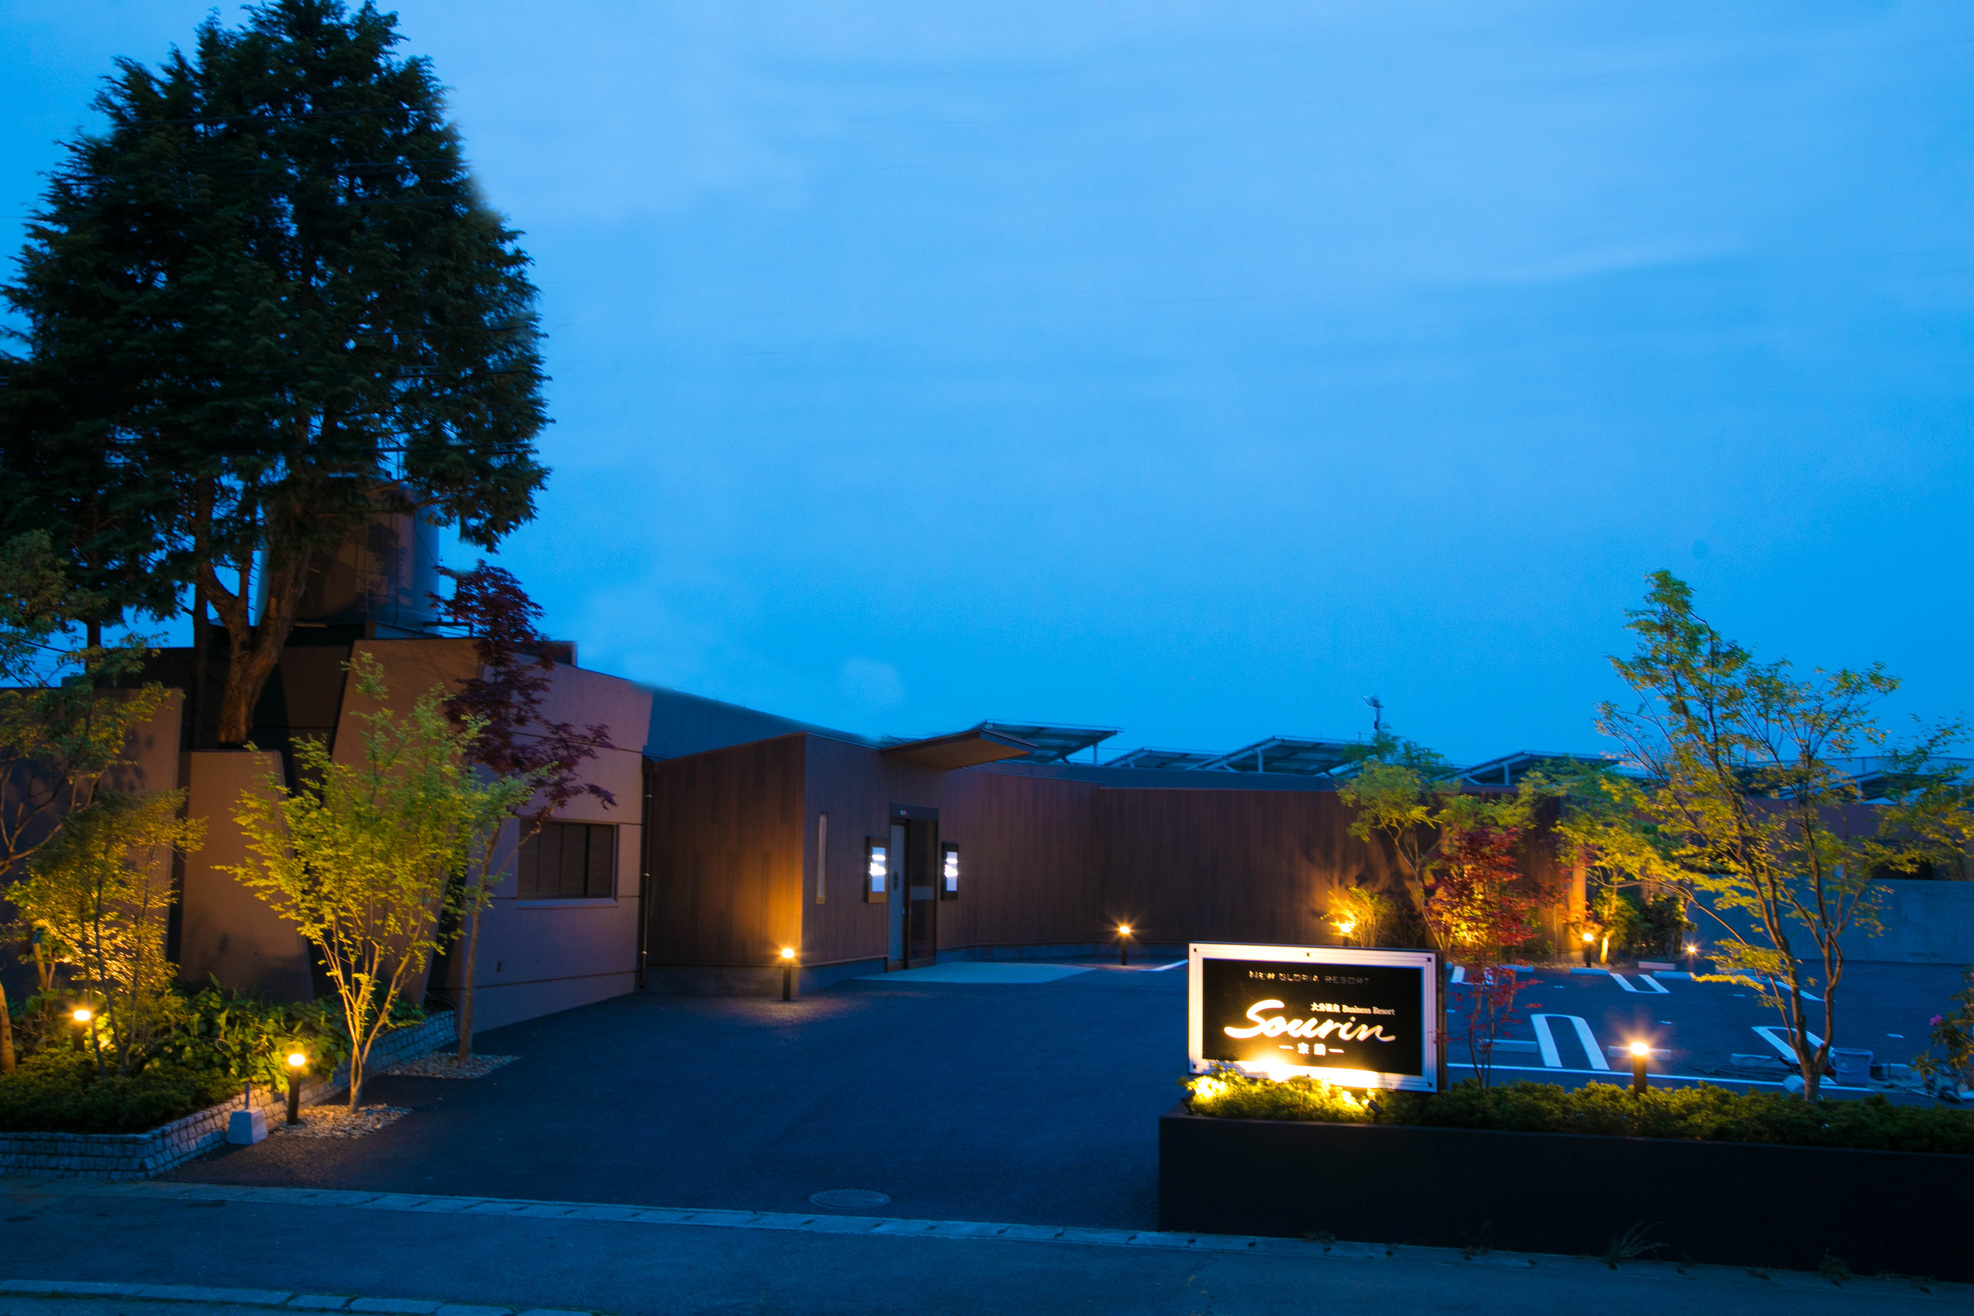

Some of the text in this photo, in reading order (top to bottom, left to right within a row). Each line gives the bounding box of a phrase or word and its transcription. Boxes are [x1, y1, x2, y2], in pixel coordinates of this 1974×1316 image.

[1249, 970, 1370, 985] NEW GLORIA RESORT
[1342, 1004, 1372, 1014] Business
[1373, 1006, 1396, 1016] Resort
[1224, 999, 1397, 1042] Sourin
